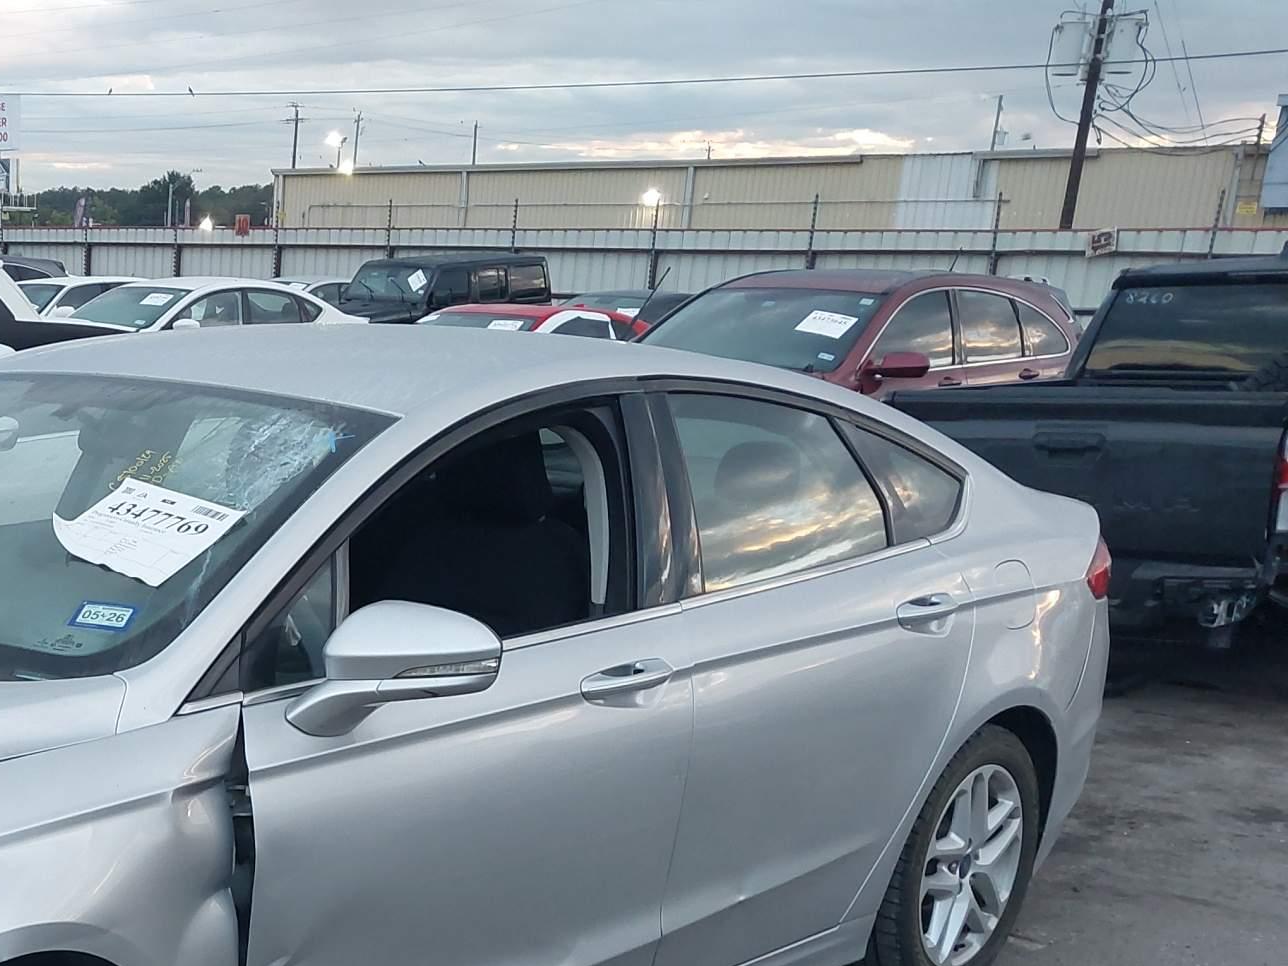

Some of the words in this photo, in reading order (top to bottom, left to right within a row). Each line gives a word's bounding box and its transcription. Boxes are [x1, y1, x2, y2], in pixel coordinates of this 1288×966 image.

[107, 500, 210, 536] 43477769
[81, 609, 102, 621] 05
[105, 612, 127, 624] 26
